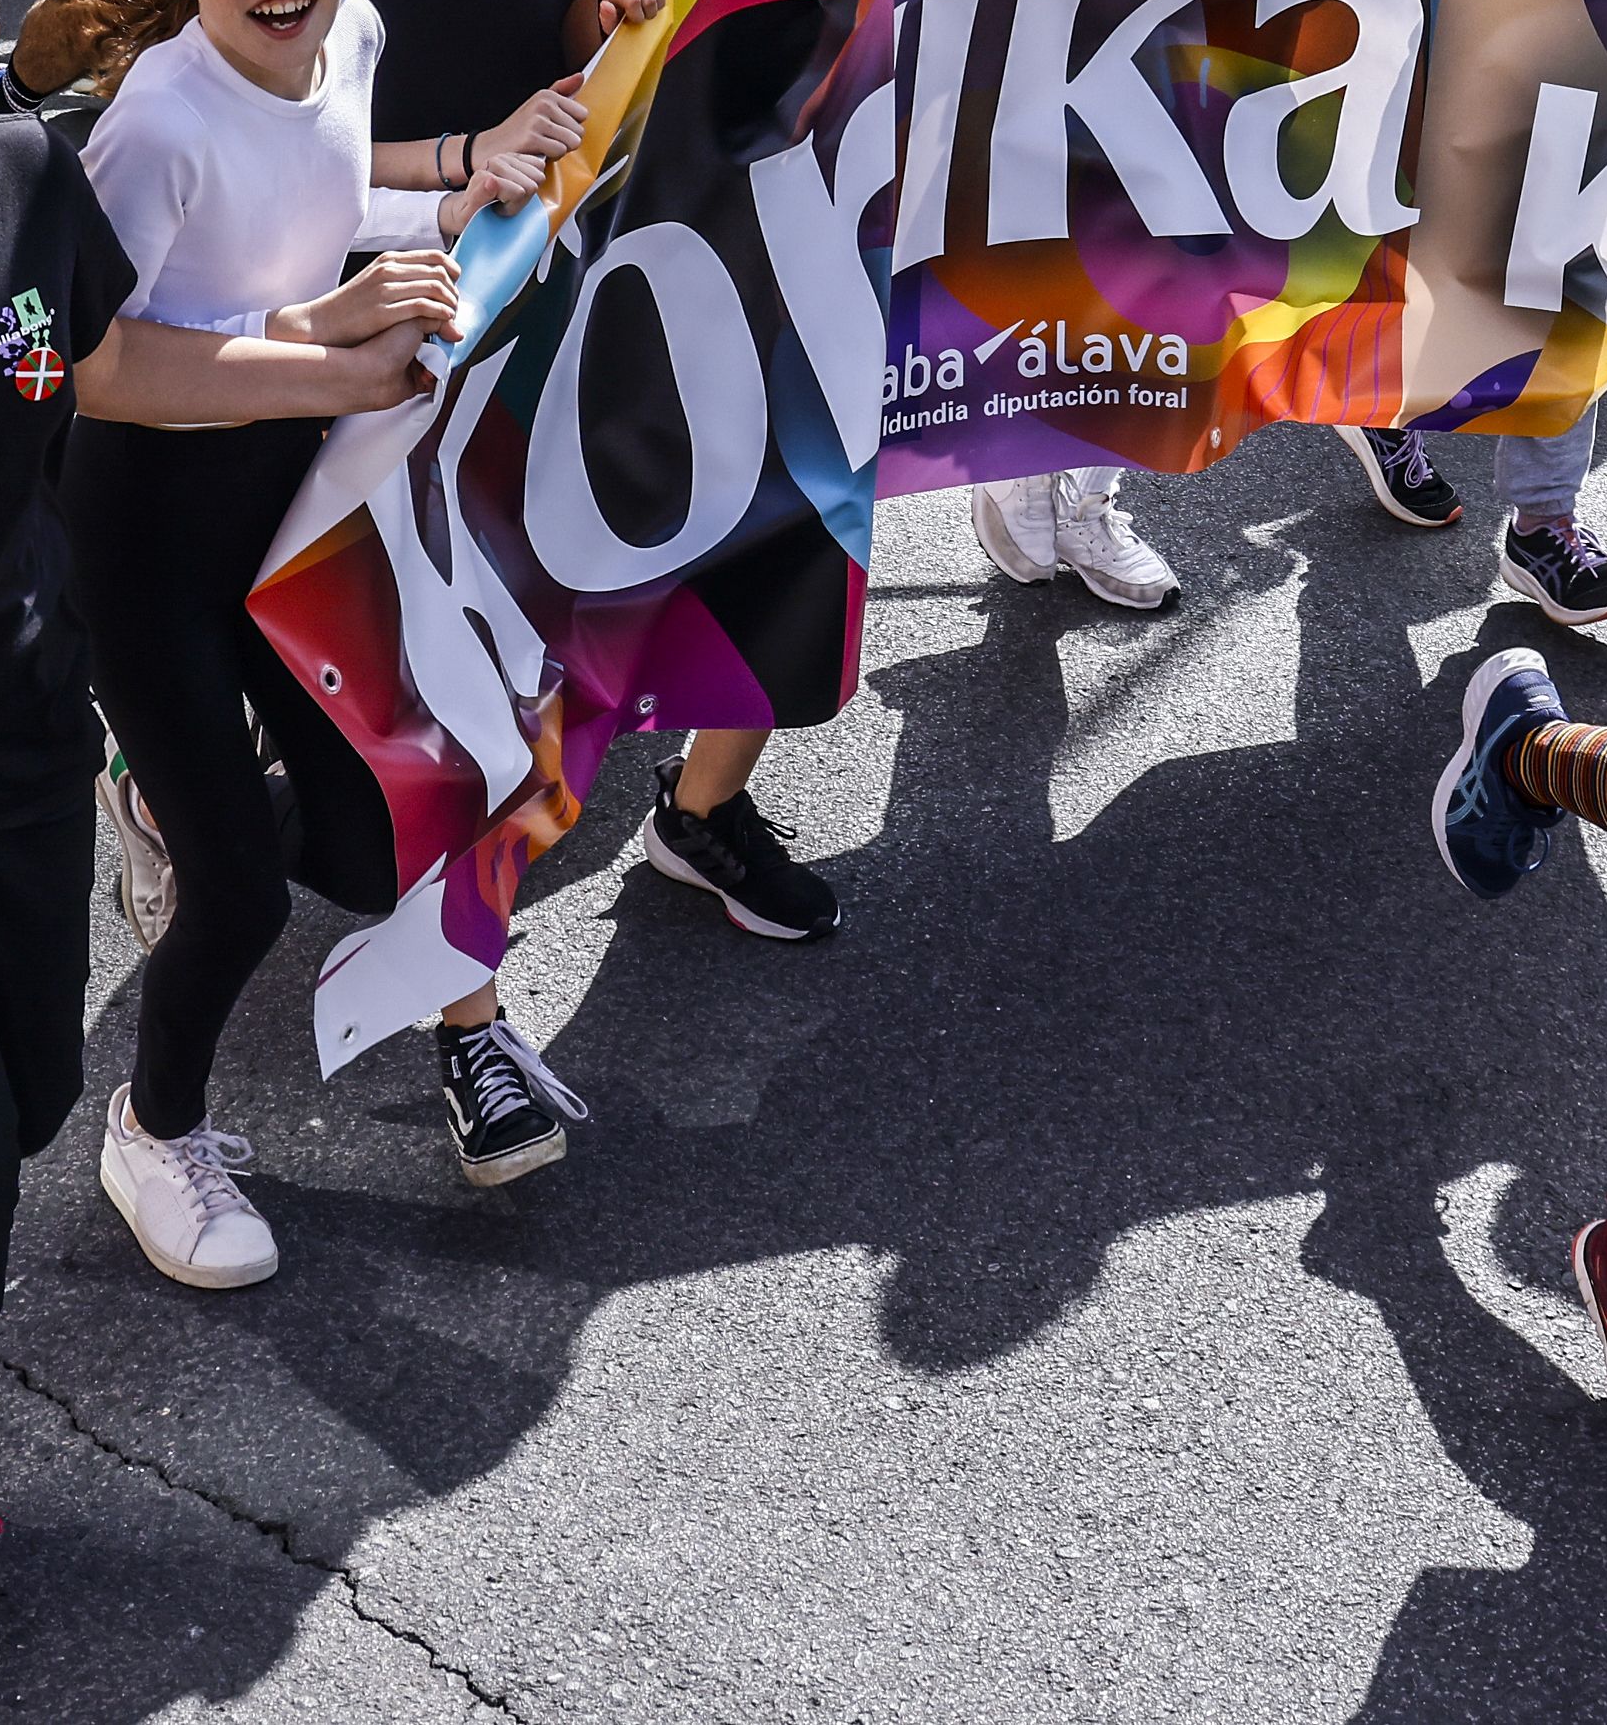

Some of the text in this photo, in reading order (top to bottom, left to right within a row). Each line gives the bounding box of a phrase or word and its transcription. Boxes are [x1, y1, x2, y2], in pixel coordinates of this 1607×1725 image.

[1017, 320, 1189, 379] álava
[882, 383, 1188, 437] ldundia diputación foral
